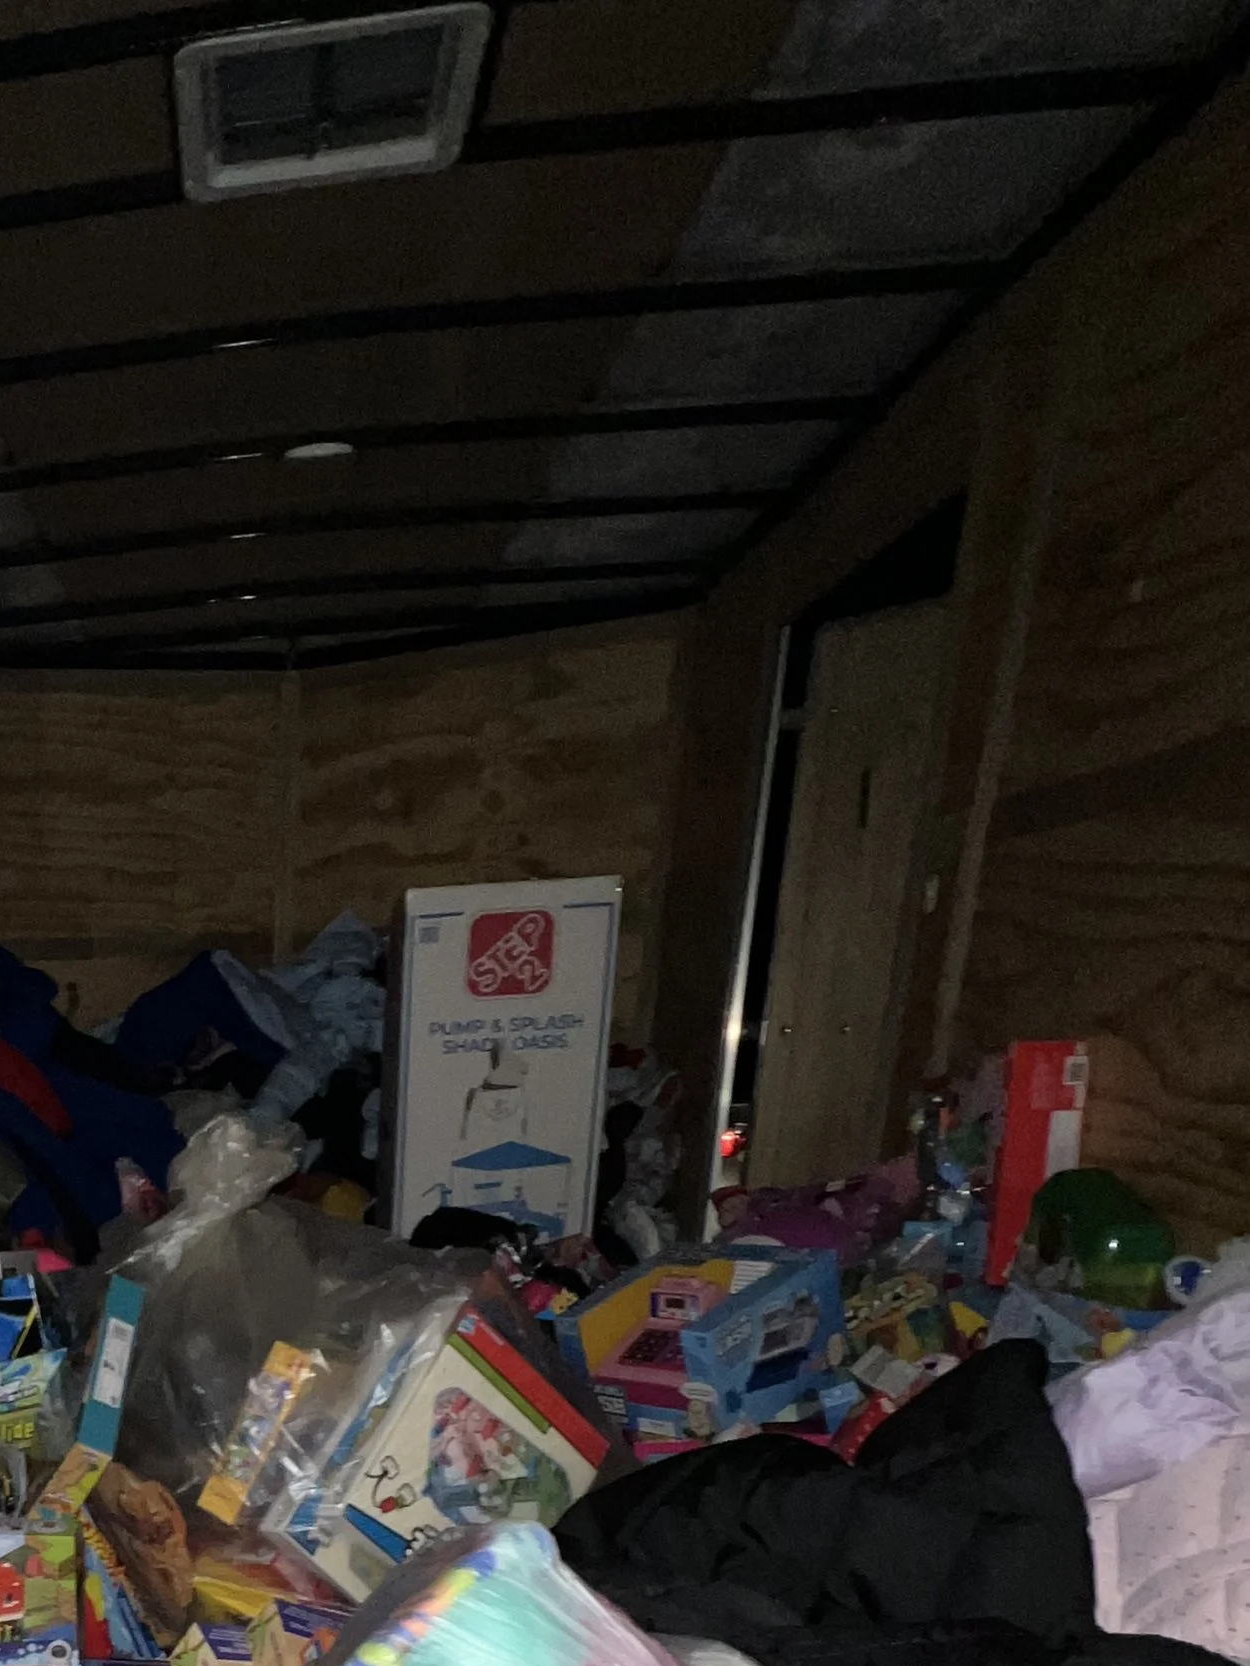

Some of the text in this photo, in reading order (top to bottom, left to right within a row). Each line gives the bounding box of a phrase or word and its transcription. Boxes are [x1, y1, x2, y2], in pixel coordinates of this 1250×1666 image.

[471, 912, 546, 993] STEP
[519, 955, 549, 991] 2
[430, 1021, 484, 1035] PUMP
[510, 1014, 585, 1032] SPLASH
[442, 1033, 569, 1054] SHAD OASIS
